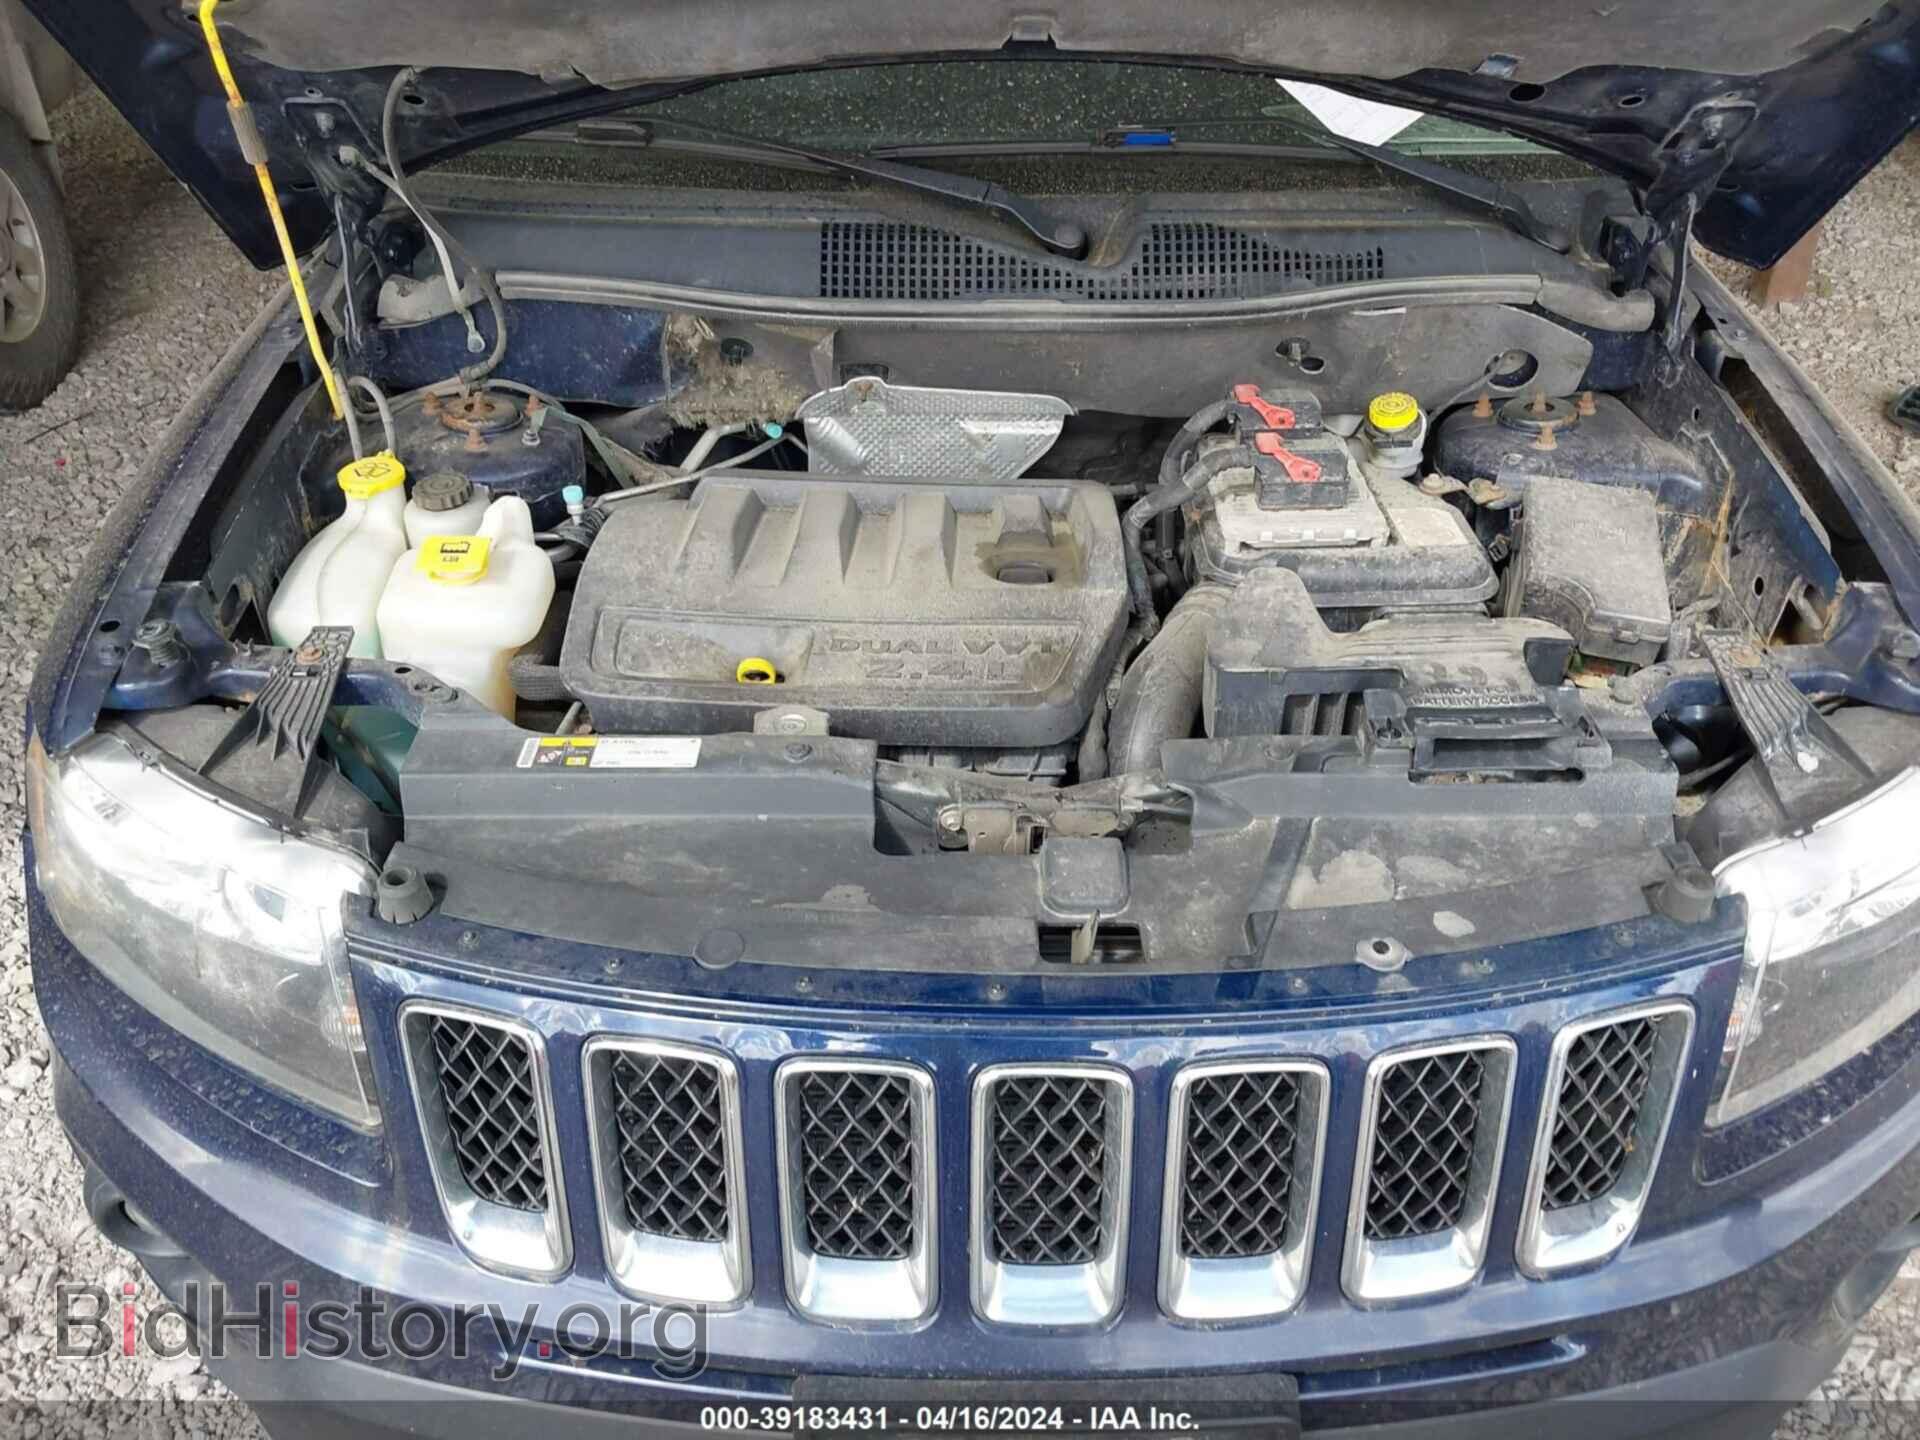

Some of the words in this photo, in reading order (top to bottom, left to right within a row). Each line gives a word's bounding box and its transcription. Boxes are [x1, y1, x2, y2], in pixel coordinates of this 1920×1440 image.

[828, 638, 952, 654] DUAL
[962, 637, 1058, 656] VVT
[864, 658, 1024, 682] 2.4L
[1419, 686, 1482, 696] REMOVE
[1409, 695, 1478, 705] BATTERY
[1480, 694, 1541, 705] ACCESS
